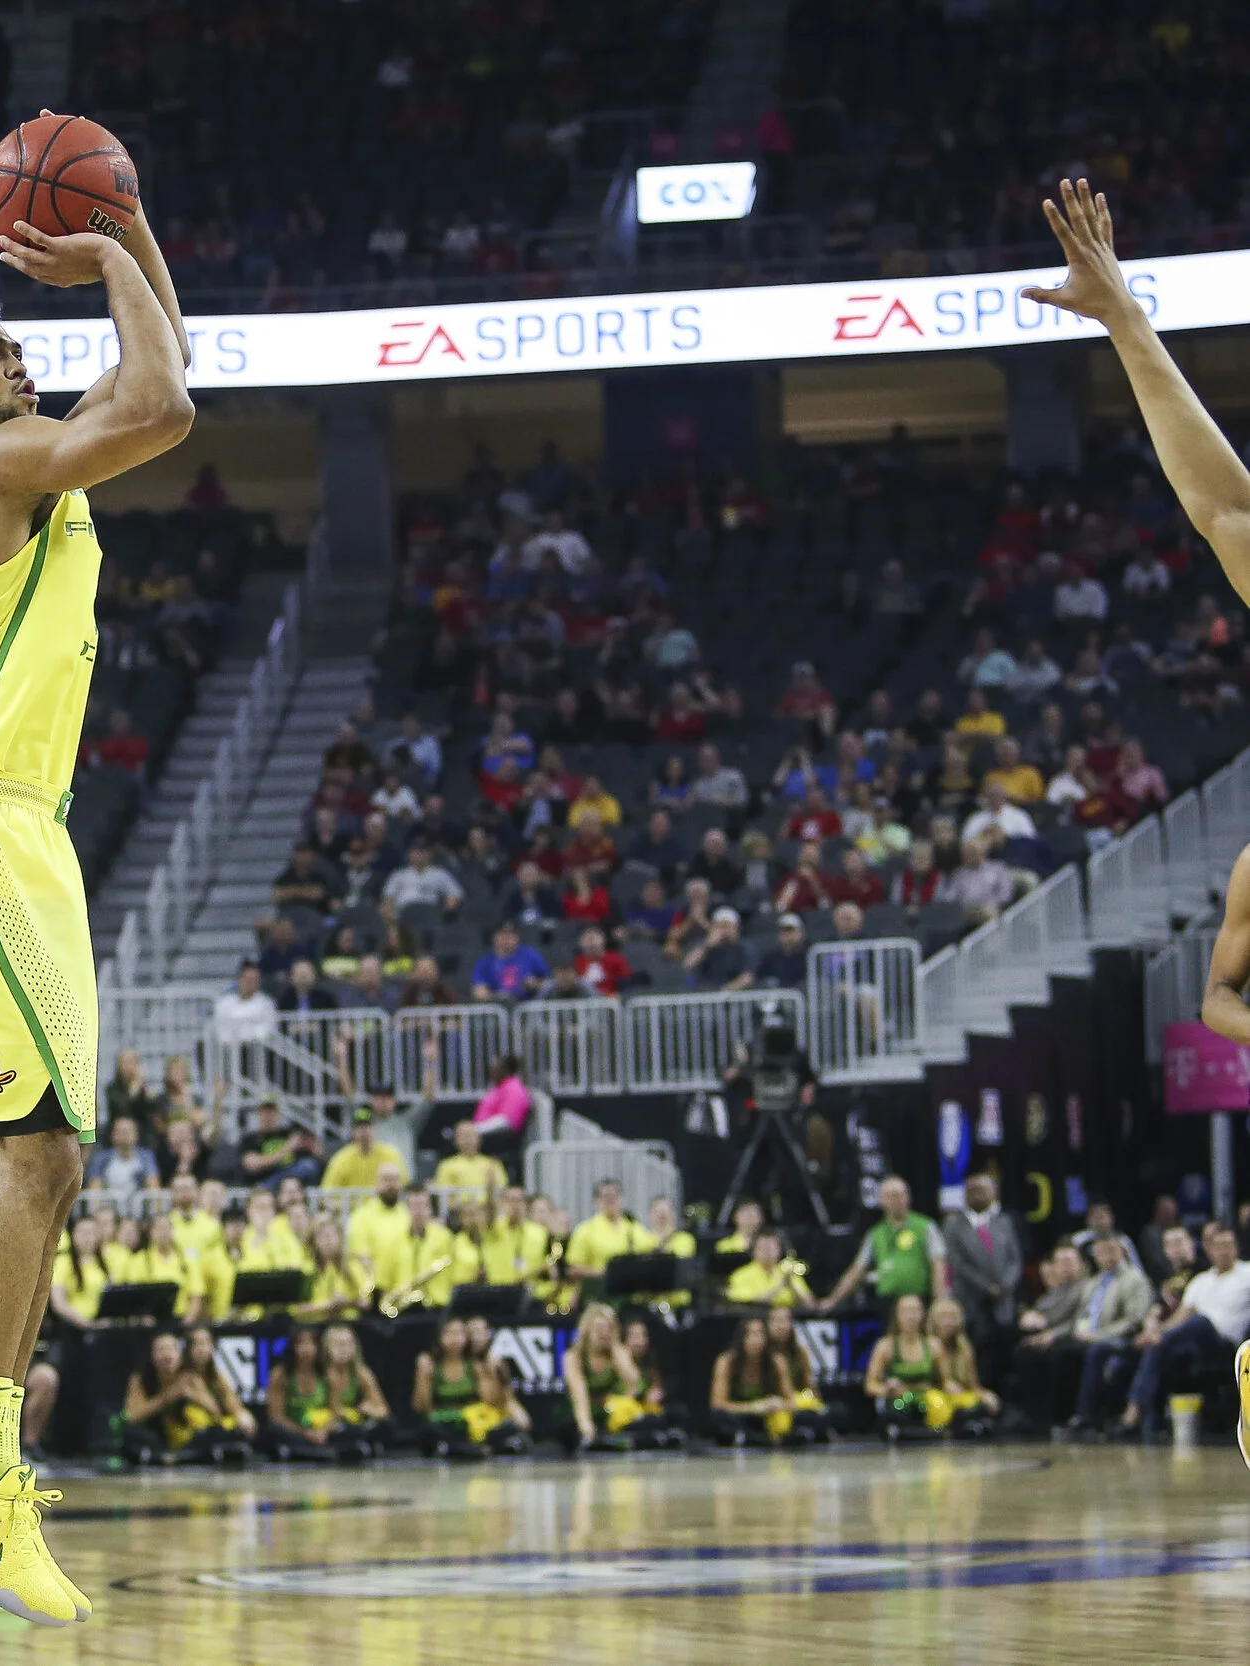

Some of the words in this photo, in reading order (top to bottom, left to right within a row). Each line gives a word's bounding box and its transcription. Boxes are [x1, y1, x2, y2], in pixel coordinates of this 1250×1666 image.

[377, 322, 465, 366] EA
[476, 305, 702, 361] SPORTS
[834, 295, 924, 340] EA
[21, 329, 247, 378] SPOTS
